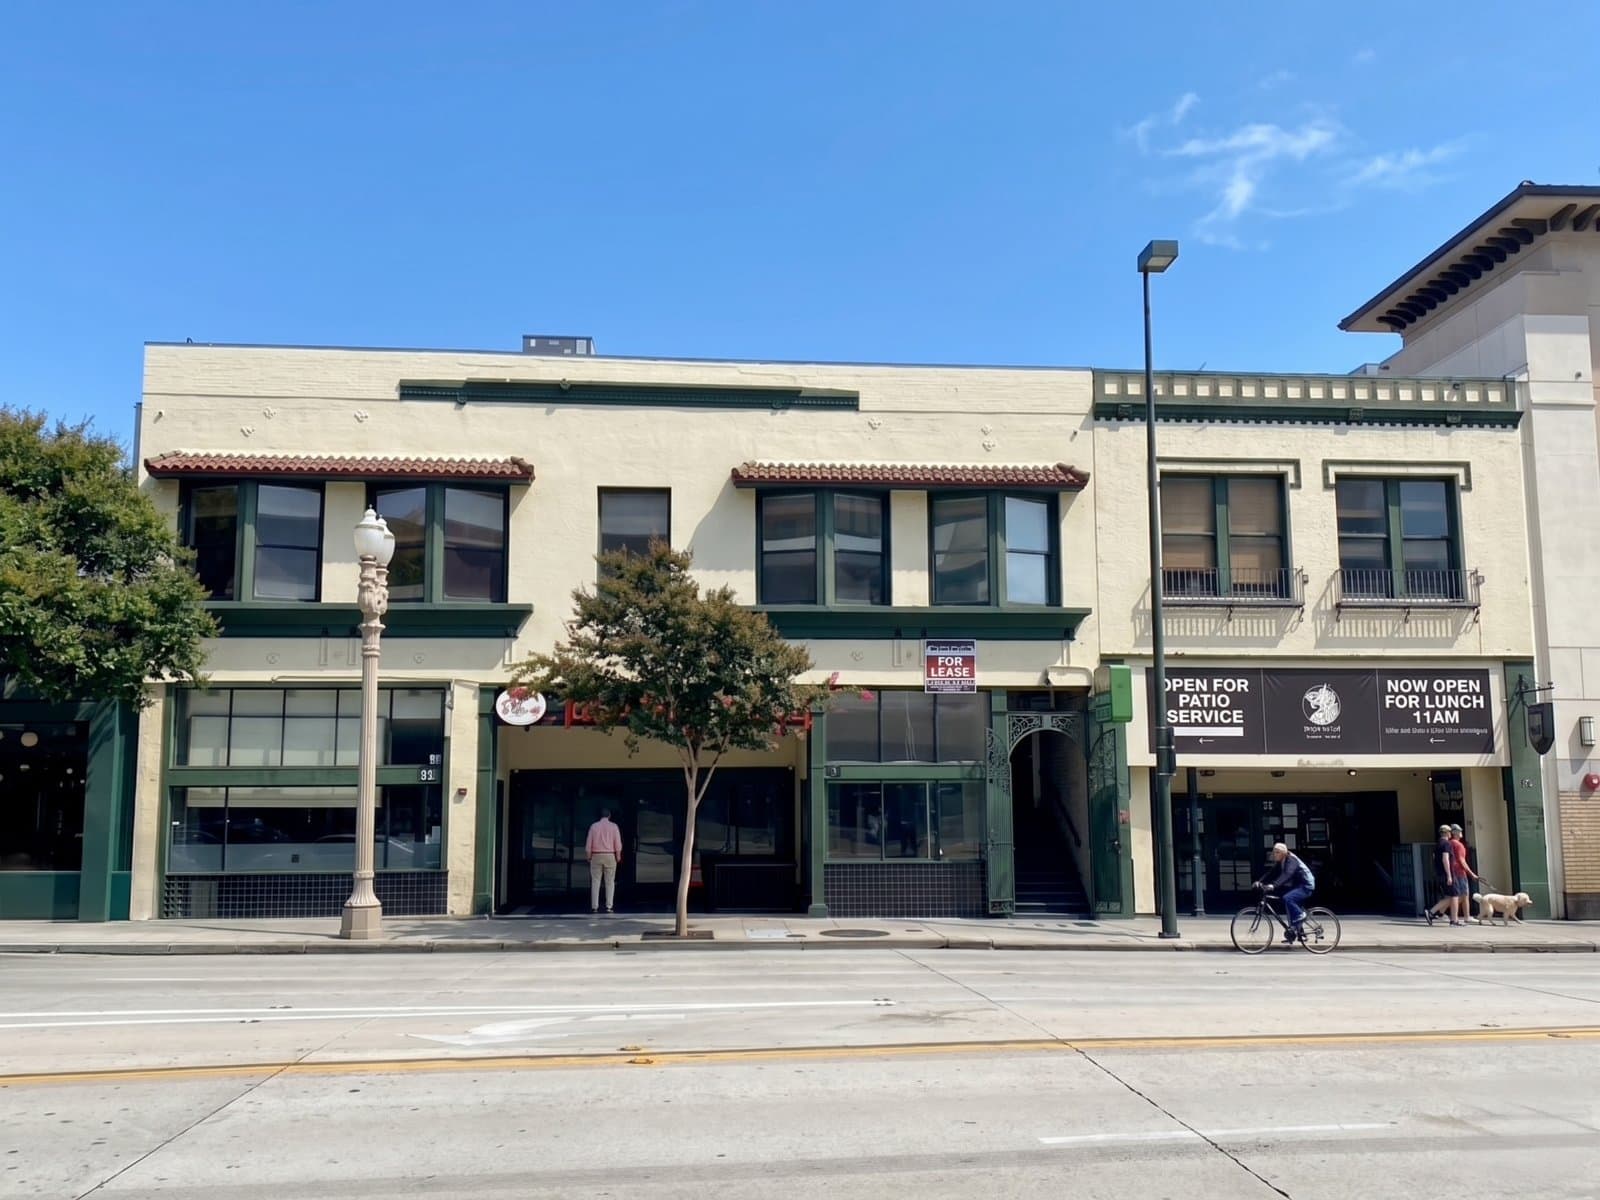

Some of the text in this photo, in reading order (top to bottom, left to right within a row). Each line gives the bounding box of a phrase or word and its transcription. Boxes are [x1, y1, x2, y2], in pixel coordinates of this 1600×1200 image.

[938, 657, 963, 666] FOR
[930, 667, 970, 677] LEASE
[1213, 678, 1249, 692] FOR
[1387, 679, 1480, 693] NOW OPEN
[1179, 694, 1230, 707] PATIO
[1385, 695, 1484, 708] FOR LUNCH
[1167, 709, 1244, 723] SERVICE
[1413, 710, 1460, 724] 11AM
